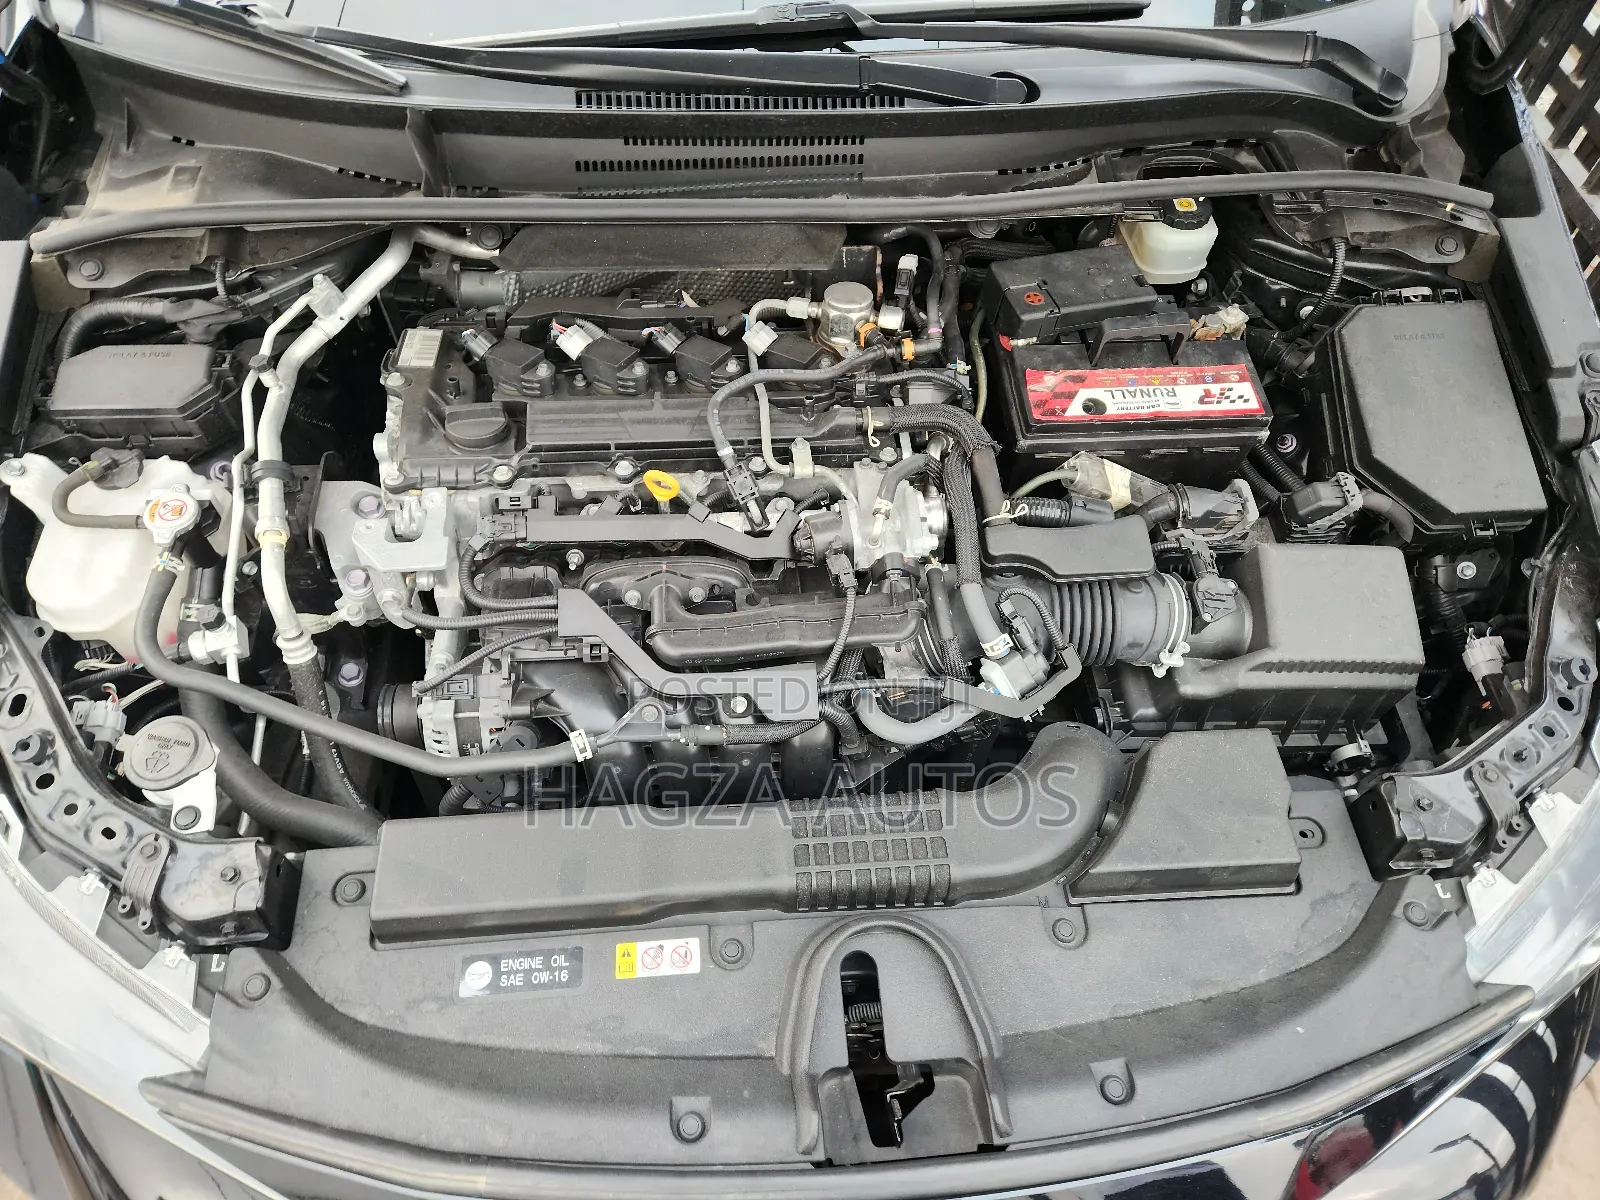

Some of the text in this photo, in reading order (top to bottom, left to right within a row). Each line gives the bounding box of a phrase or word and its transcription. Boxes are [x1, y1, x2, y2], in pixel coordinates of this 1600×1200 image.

[1103, 387, 1177, 400] RUNALL
[1147, 403, 1161, 411] CAR
[500, 954, 570, 972] ENGINE OIL
[499, 969, 569, 987] SAE 0W-16
